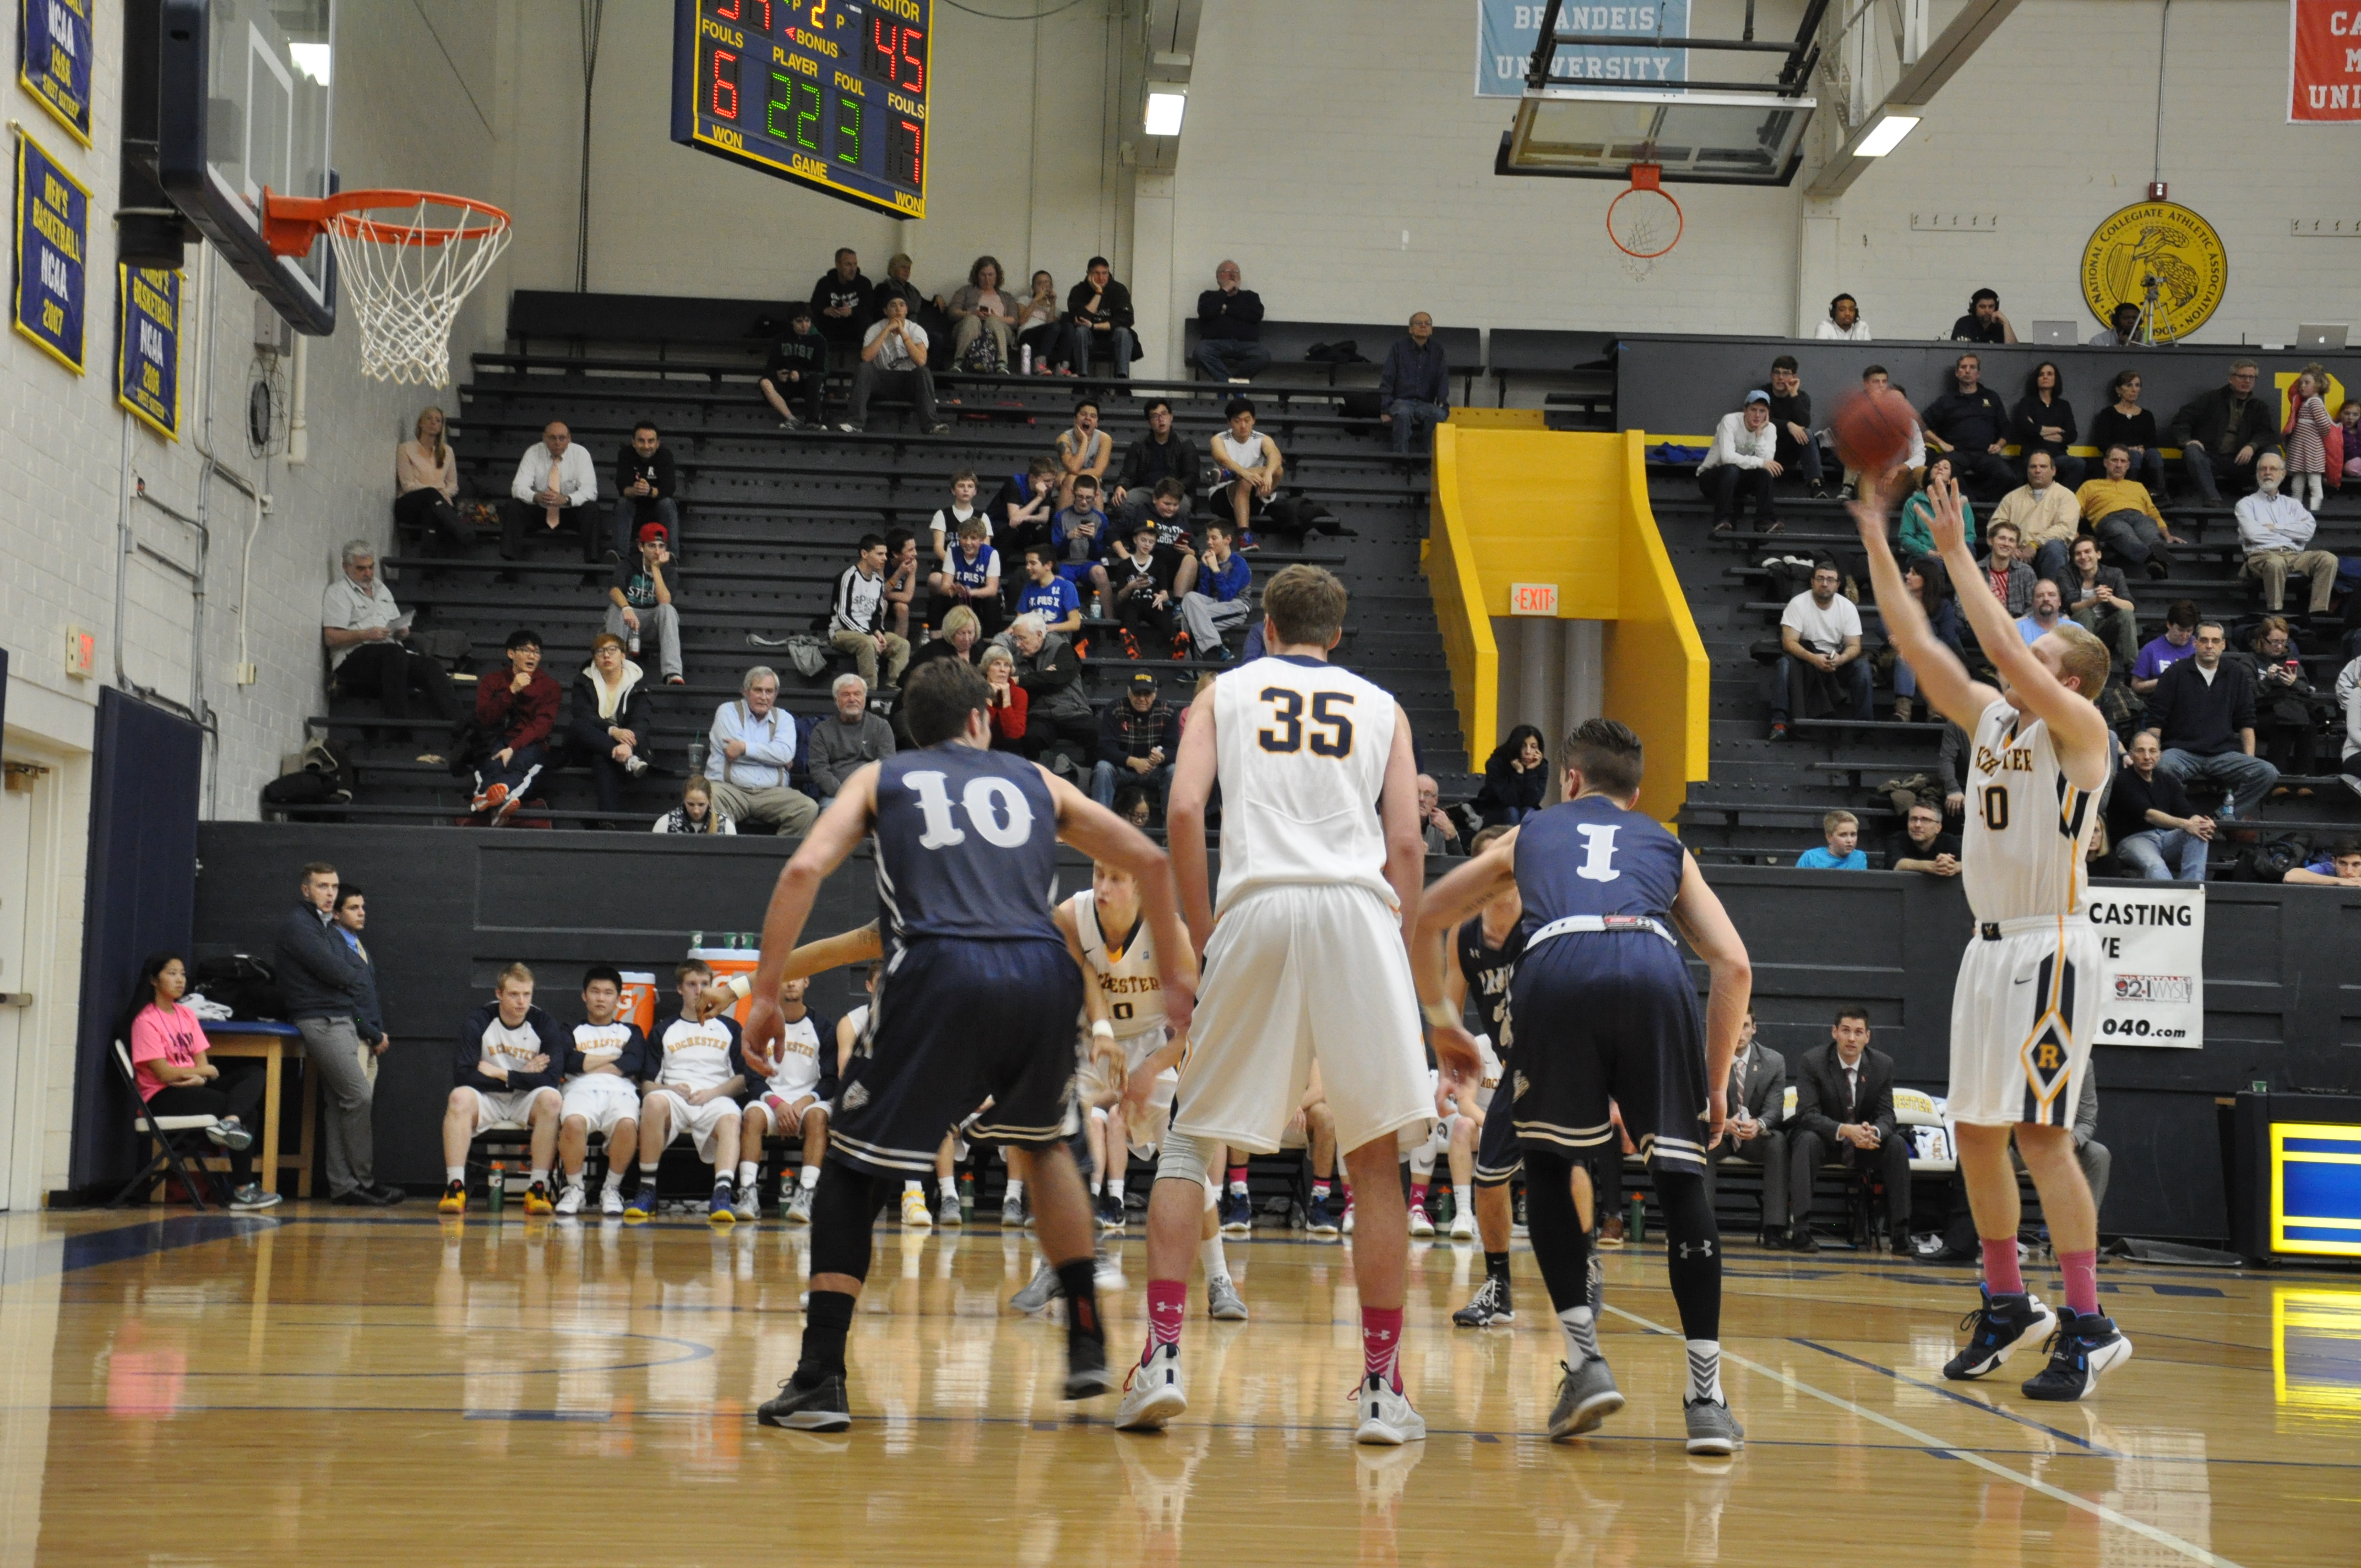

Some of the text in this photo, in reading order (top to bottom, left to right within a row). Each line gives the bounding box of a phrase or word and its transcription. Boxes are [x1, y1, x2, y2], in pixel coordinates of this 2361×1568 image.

[48, 0, 74, 57] NCAA
[796, 29, 839, 58] BONUS
[702, 18, 923, 93] FOULS 45
[1497, 56, 1671, 80] UNVERSITY
[773, 45, 924, 119] PLAYER FOUL FOULS
[712, 125, 743, 149] WON
[713, 50, 921, 184] 6 22 3 7
[792, 153, 828, 179] GAME
[45, 172, 69, 220] MEN'S
[894, 190, 922, 214] WON
[32, 196, 81, 265] BASKETBALL
[41, 245, 69, 302] NCAA
[2088, 208, 2220, 326] NATIONAL COLLEGIATE ATHLETIC ASSOCIATION
[42, 298, 64, 338] 2007
[133, 275, 173, 333] BASKETBALL
[140, 318, 164, 368] NCAA
[1520, 587, 1552, 611] EXIT
[80, 634, 94, 671] EXIT
[1257, 685, 1357, 761] 35
[901, 770, 1036, 851] 10
[1576, 823, 1622, 883] 1
[667, 1036, 727, 1054] ROCHESTER
[2038, 1043, 2060, 1069] R
